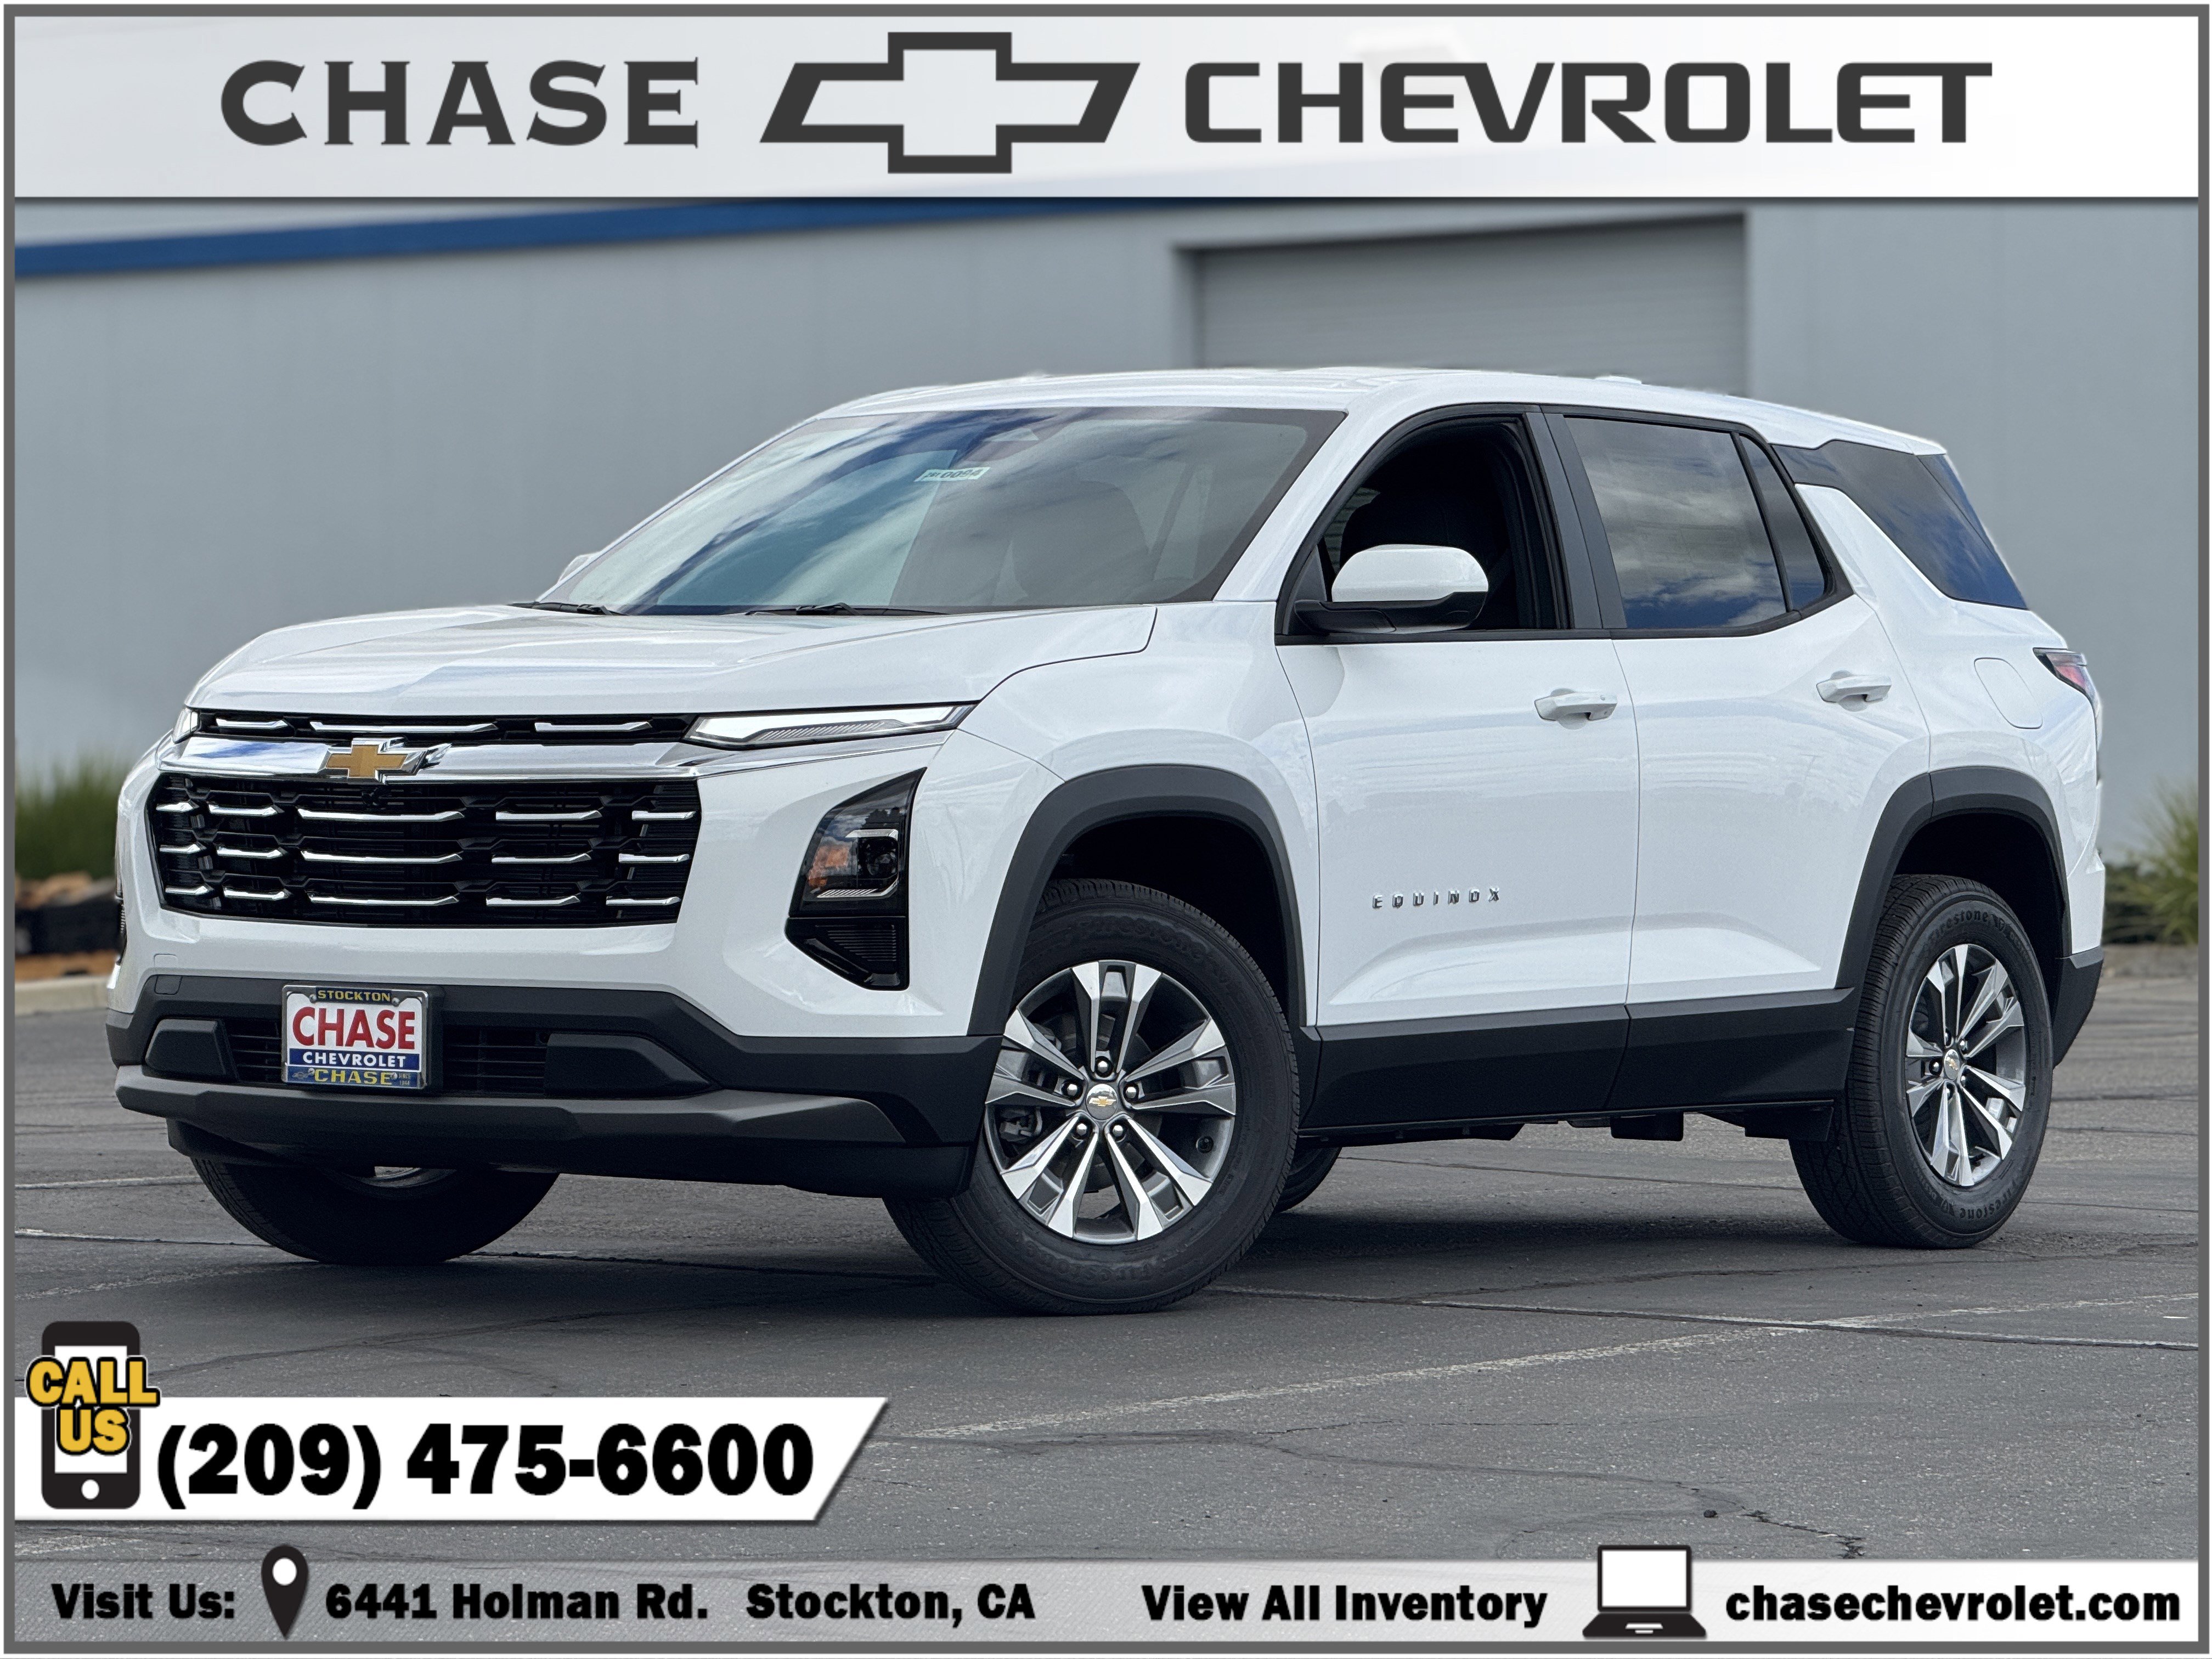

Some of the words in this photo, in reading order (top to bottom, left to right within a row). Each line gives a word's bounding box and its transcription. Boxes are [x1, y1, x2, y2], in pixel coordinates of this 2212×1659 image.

[1372, 887, 1500, 909] EQUINOX
[318, 990, 391, 1002] STOCKTON
[293, 1007, 415, 1049] CHASE
[303, 1052, 406, 1068] CHEVROLET
[314, 1069, 393, 1086] CHASE
